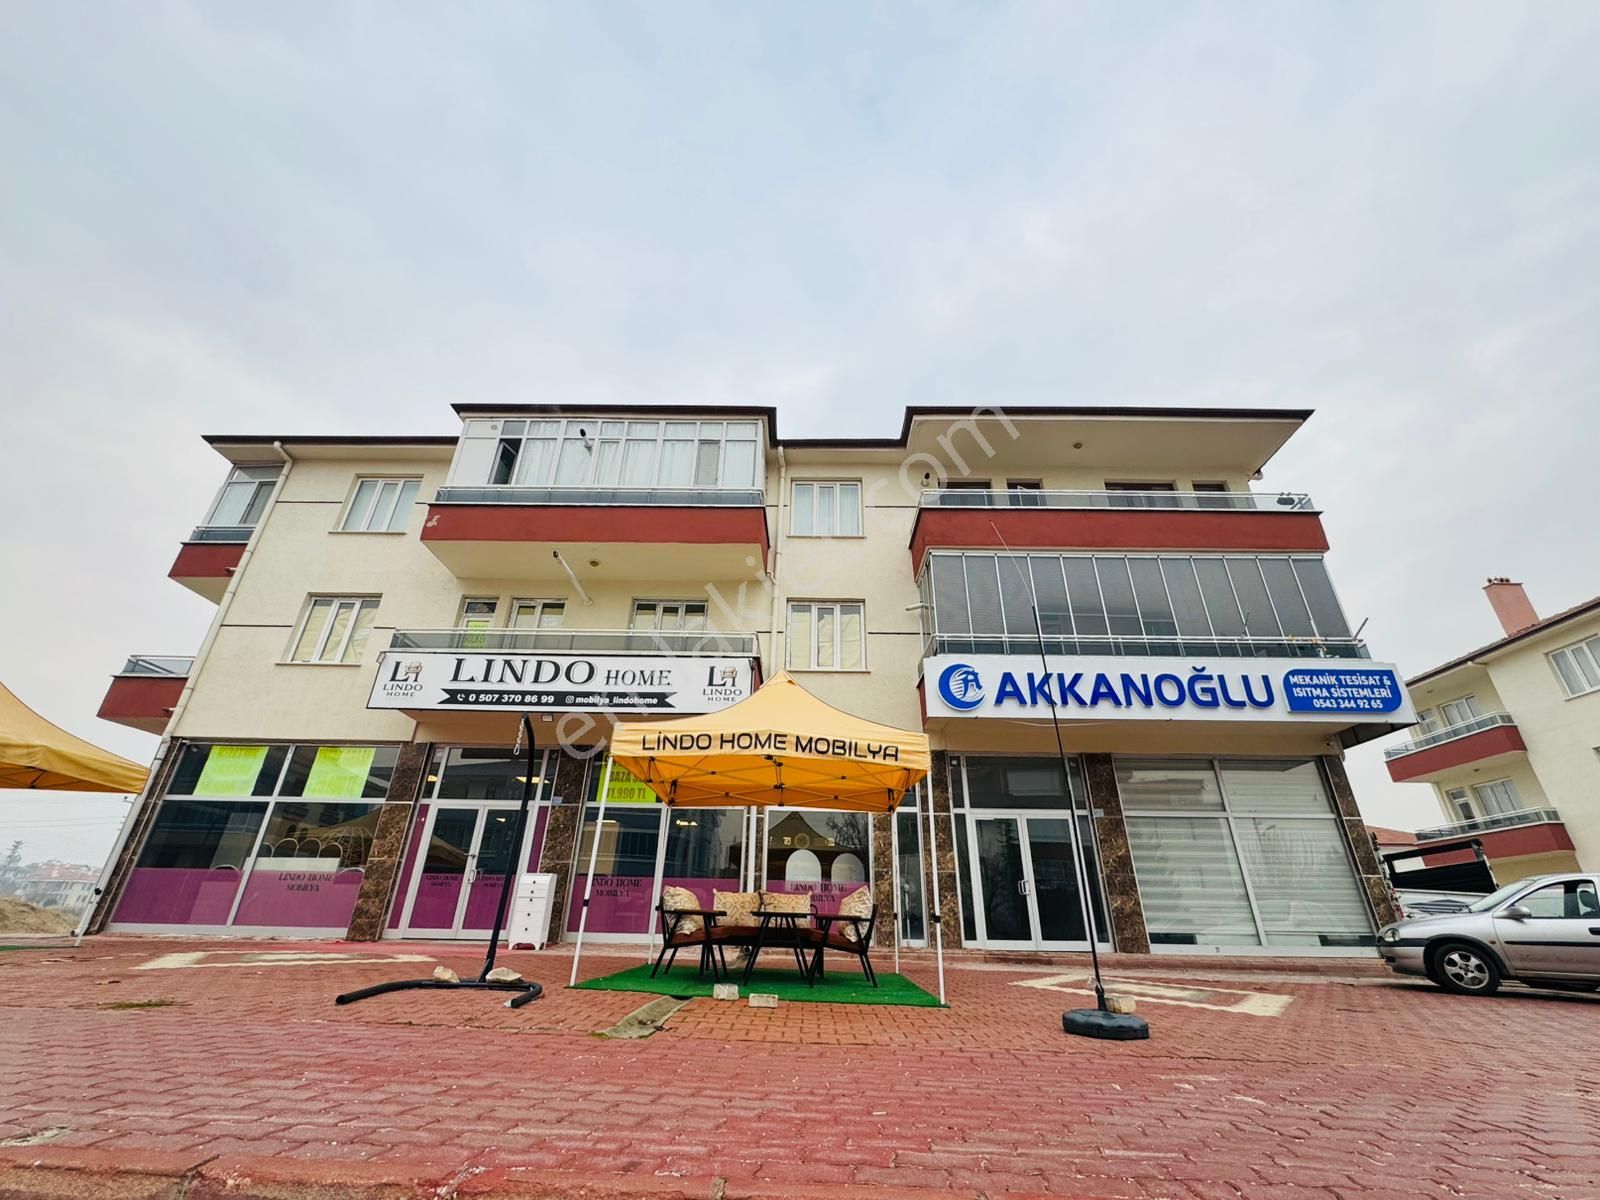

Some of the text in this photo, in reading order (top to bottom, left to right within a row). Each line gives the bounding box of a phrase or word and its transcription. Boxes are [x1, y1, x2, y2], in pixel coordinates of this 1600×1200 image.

[450, 658, 672, 687] LINDO HOME
[1288, 672, 1338, 685] MEKANİK
[1339, 672, 1380, 685] TESİSAT
[382, 683, 423, 692] LINDO
[703, 688, 742, 696] LINDO
[994, 666, 1276, 709] AKKANOĞLU
[1293, 685, 1392, 698] ISITMA SİSTEMLERİ
[468, 693, 554, 703] 0 507 370 86 99
[575, 695, 658, 706] mobilya_lindohome
[1313, 699, 1383, 709] 0543 344 92 65
[642, 731, 899, 762] LİNDO HOME MOBILYA
